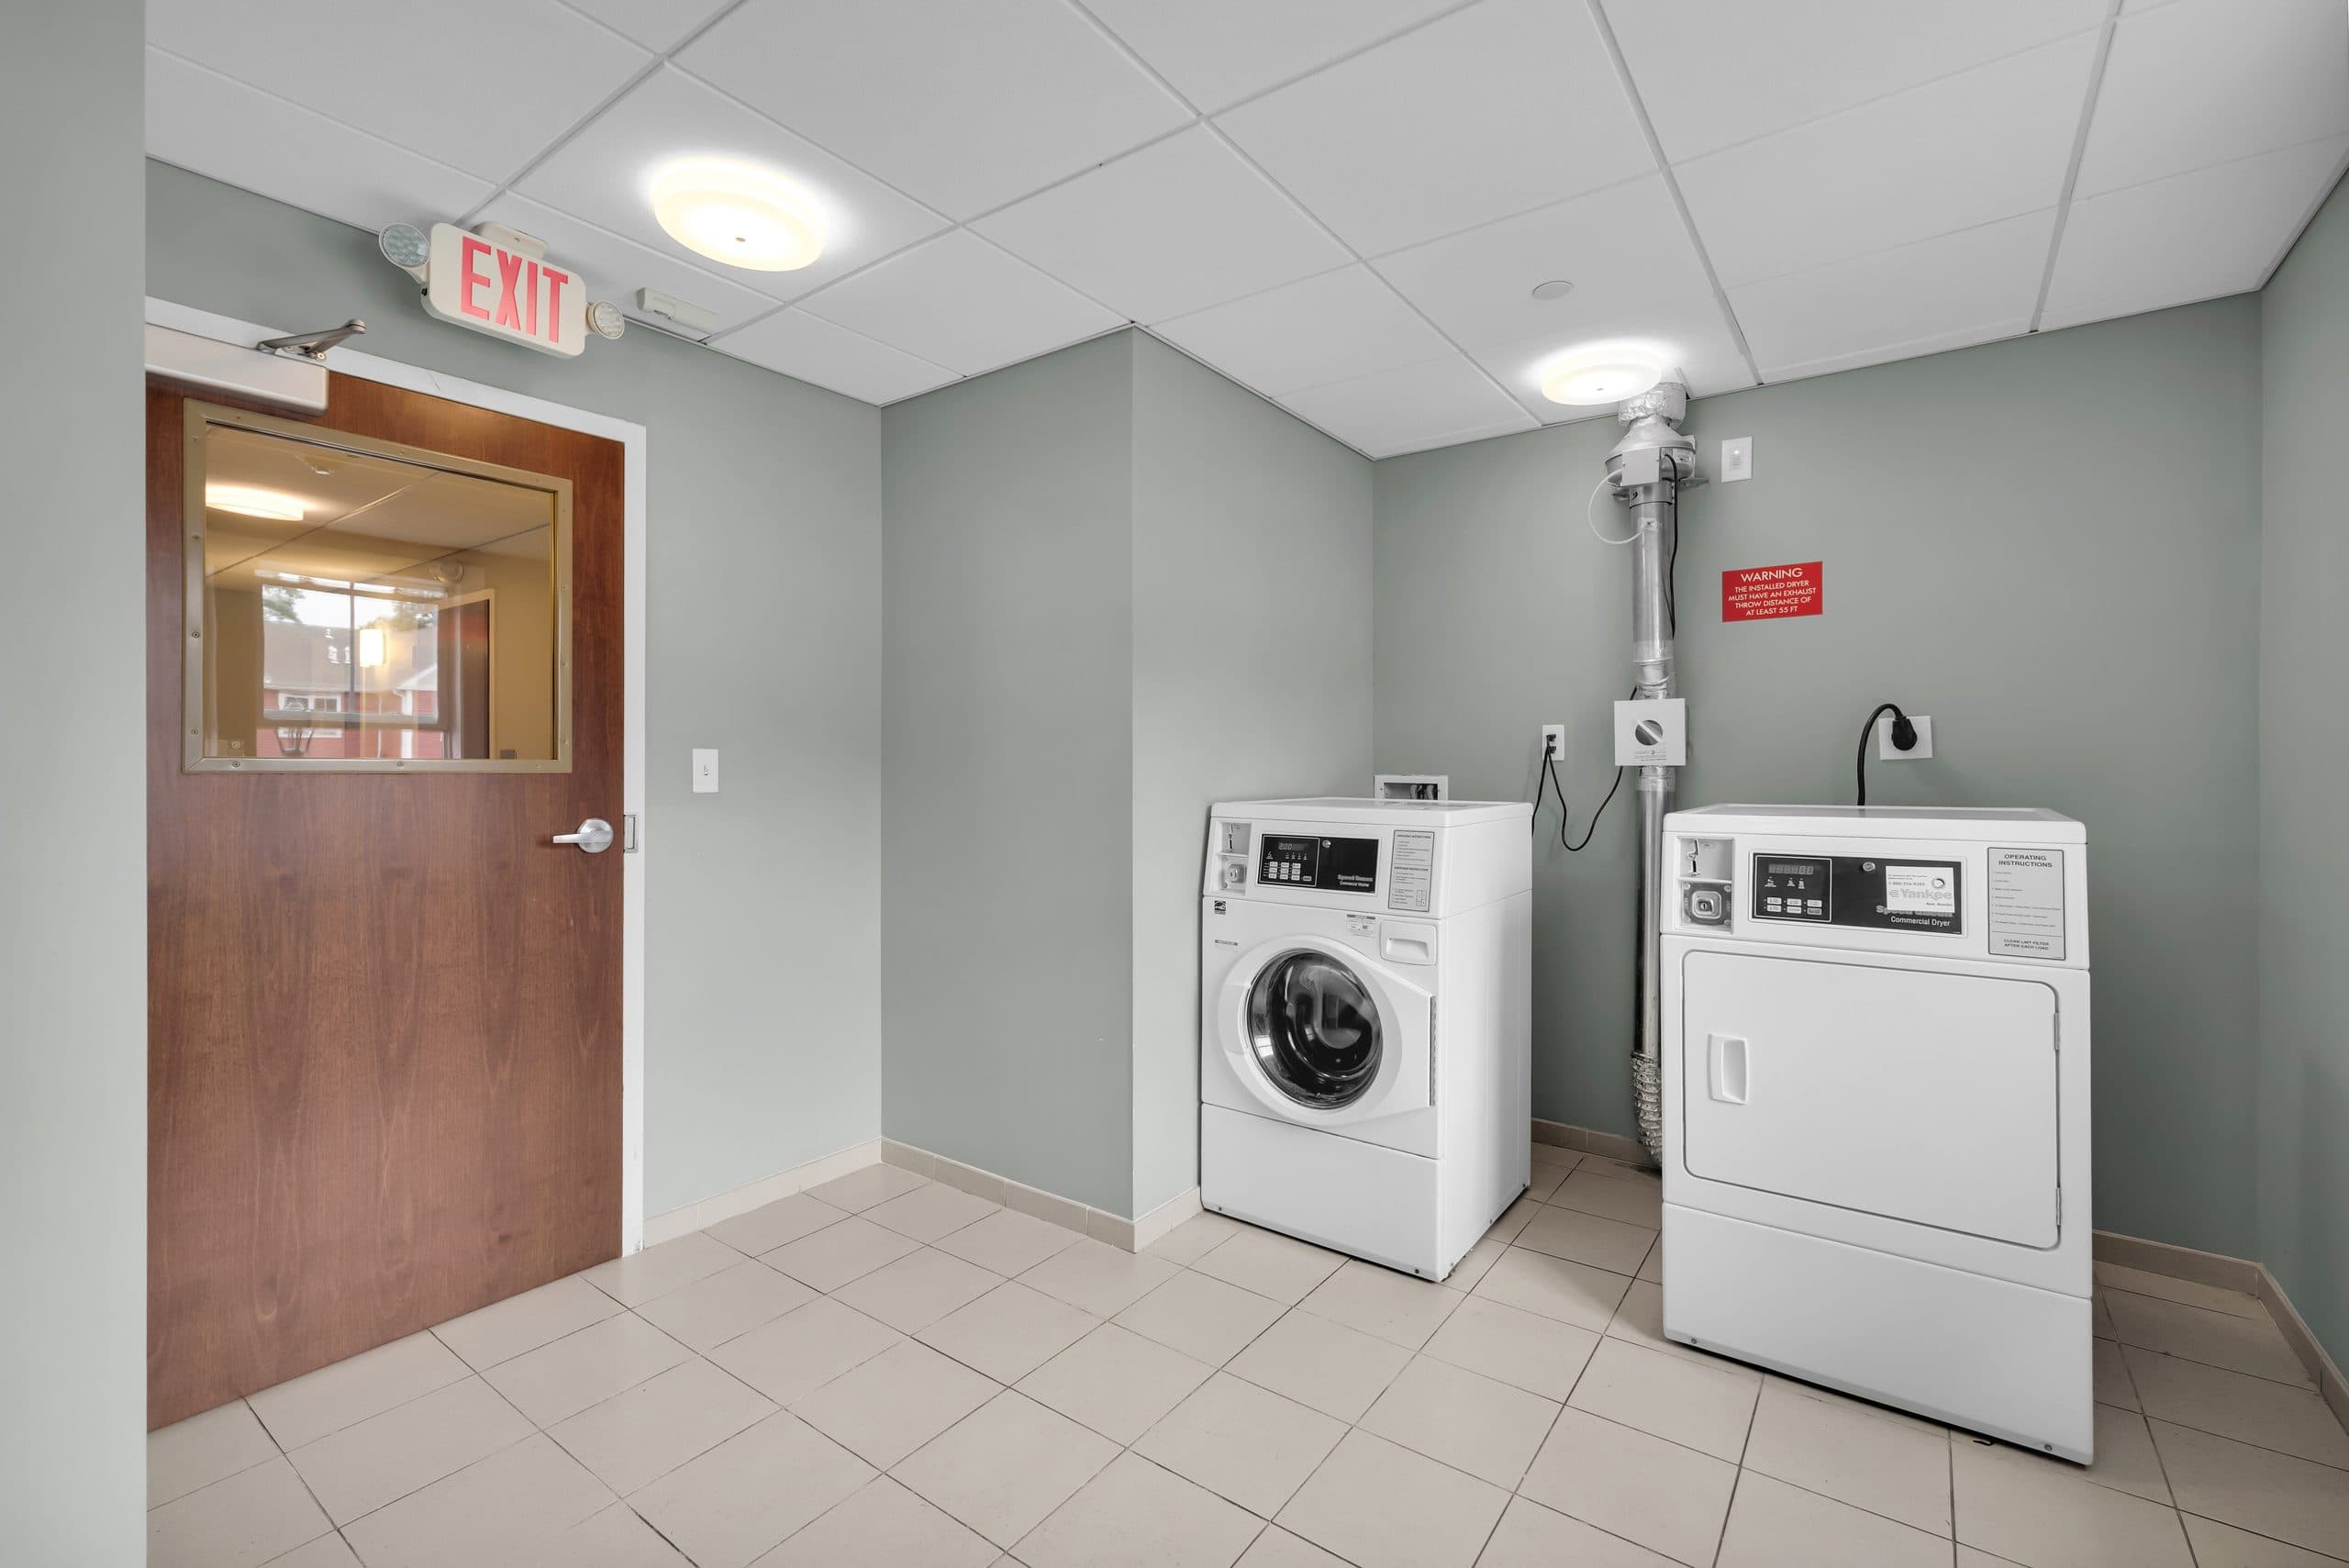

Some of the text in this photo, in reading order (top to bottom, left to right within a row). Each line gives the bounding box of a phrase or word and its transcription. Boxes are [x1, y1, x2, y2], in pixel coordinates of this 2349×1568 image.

[461, 236, 569, 344] EXIT
[1741, 568, 1803, 582] WARNING
[1749, 584, 1785, 592] INSTALLED
[1784, 587, 1816, 596] EXHAUST
[1764, 598, 1798, 606] DISTANCE
[1900, 888, 1953, 901] Yankee
[1890, 916, 1951, 928] Commercial Dryer
